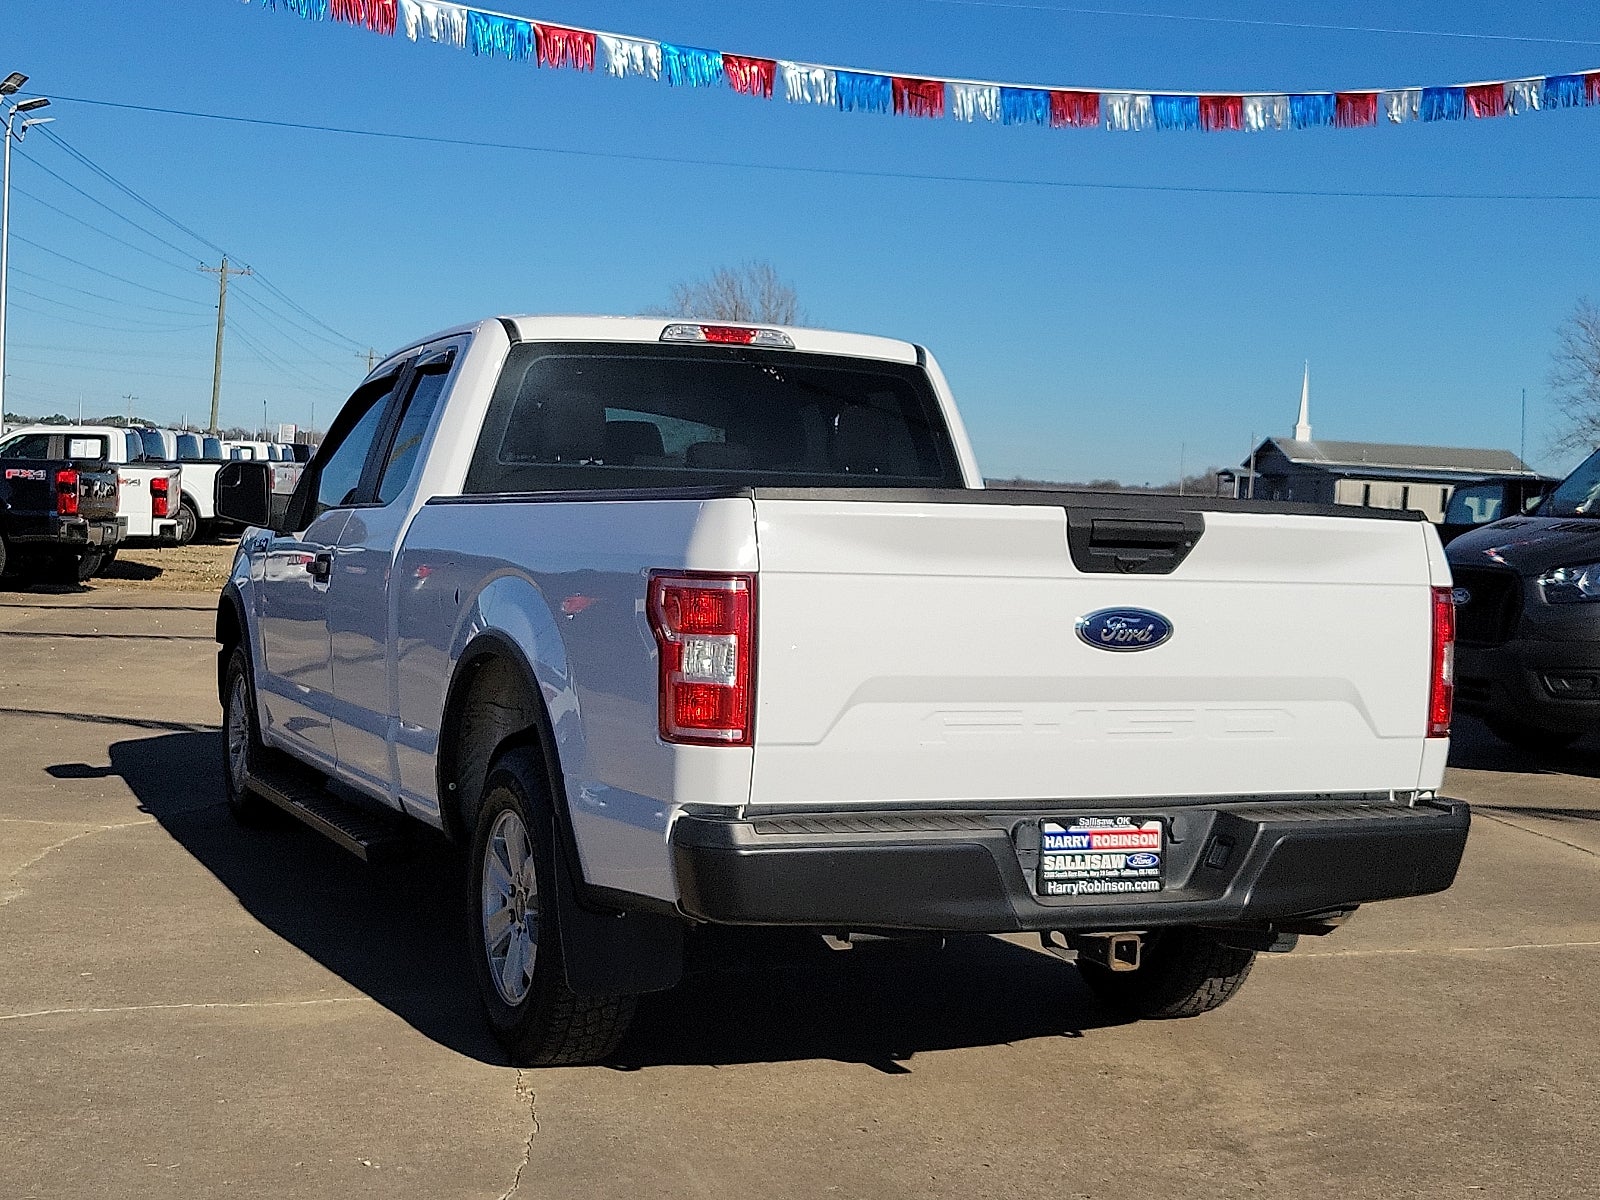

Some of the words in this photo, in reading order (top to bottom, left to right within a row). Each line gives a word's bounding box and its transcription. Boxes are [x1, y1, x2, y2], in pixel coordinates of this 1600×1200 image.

[5, 469, 47, 480] FX4
[1100, 616, 1155, 642] Ford
[1078, 817, 1115, 826] Sallisaw,
[1116, 816, 1132, 825] OK
[1044, 834, 1091, 848] HARRY
[1092, 833, 1158, 847] ROBINSON
[1043, 854, 1127, 871] SALLISAW
[1047, 880, 1160, 895] HarryRobinson.com
